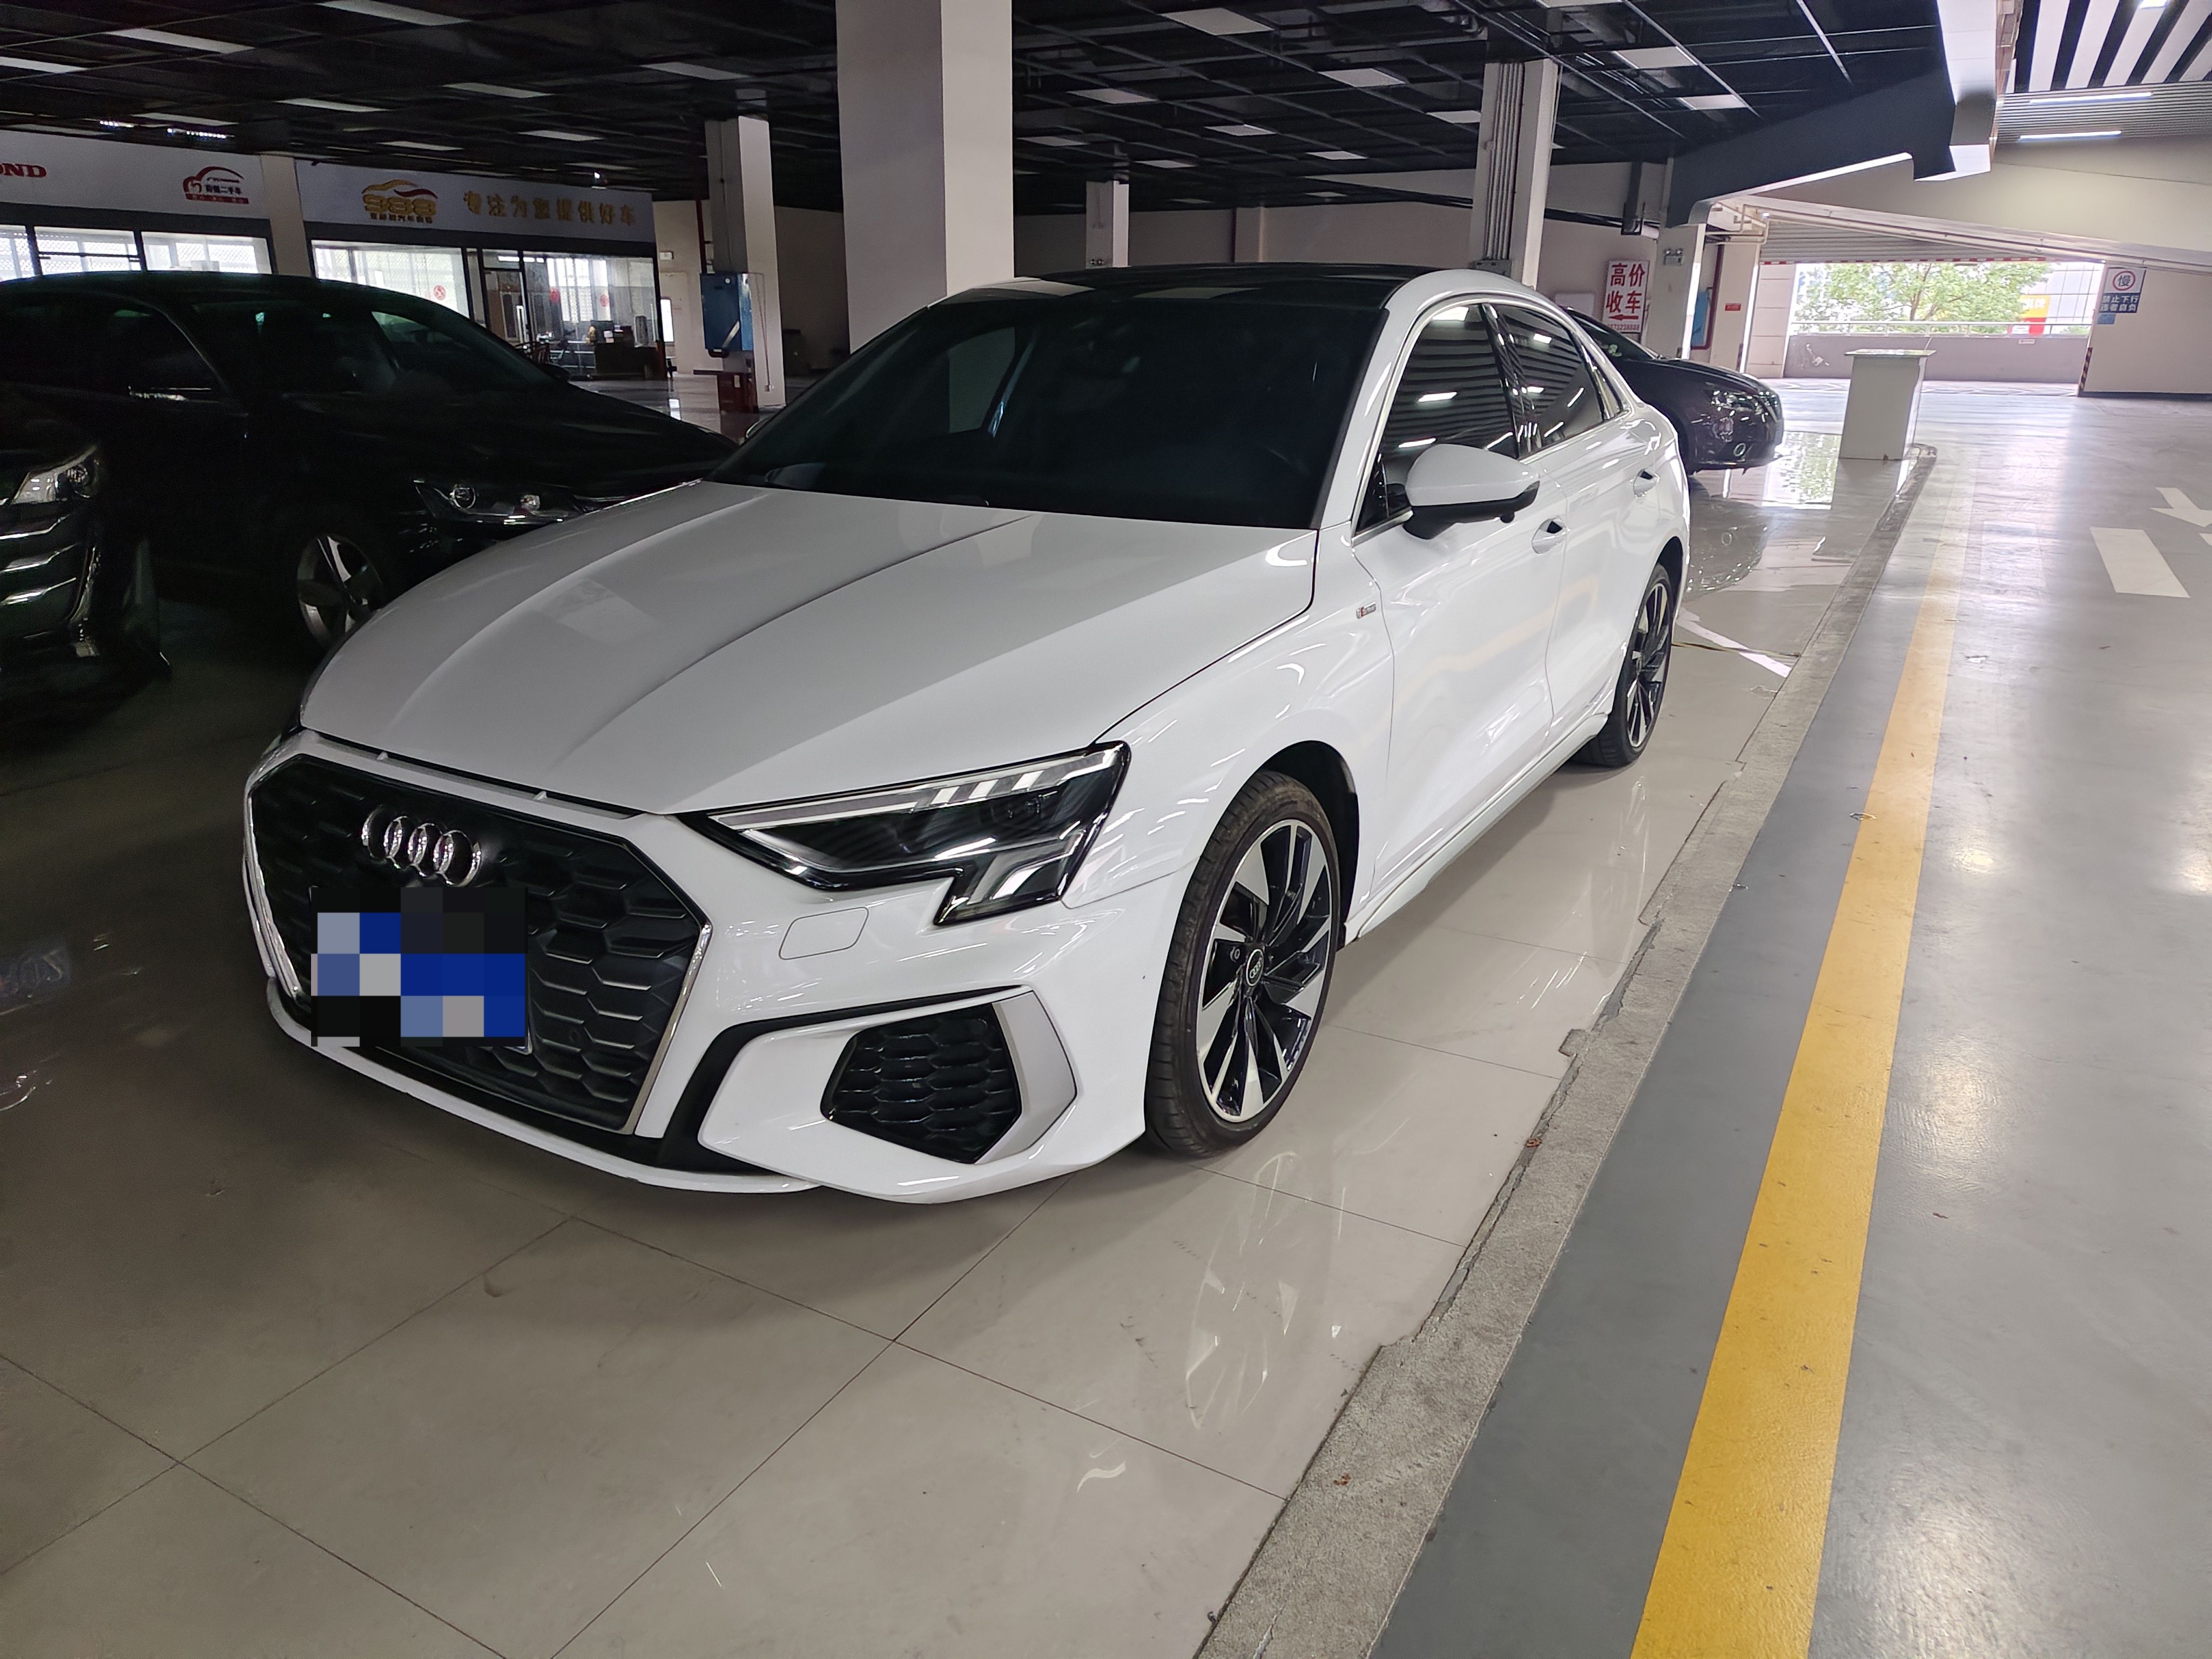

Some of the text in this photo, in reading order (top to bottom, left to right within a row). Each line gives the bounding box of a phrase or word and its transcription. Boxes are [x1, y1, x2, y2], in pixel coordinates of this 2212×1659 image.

[0, 163, 47, 178] ND
[1610, 262, 1645, 287] 高价
[2118, 275, 2131, 287] 慢
[1606, 291, 1642, 313] 收车
[2102, 295, 2140, 303] 禁止下行
[2099, 303, 2137, 312] 违者自负
